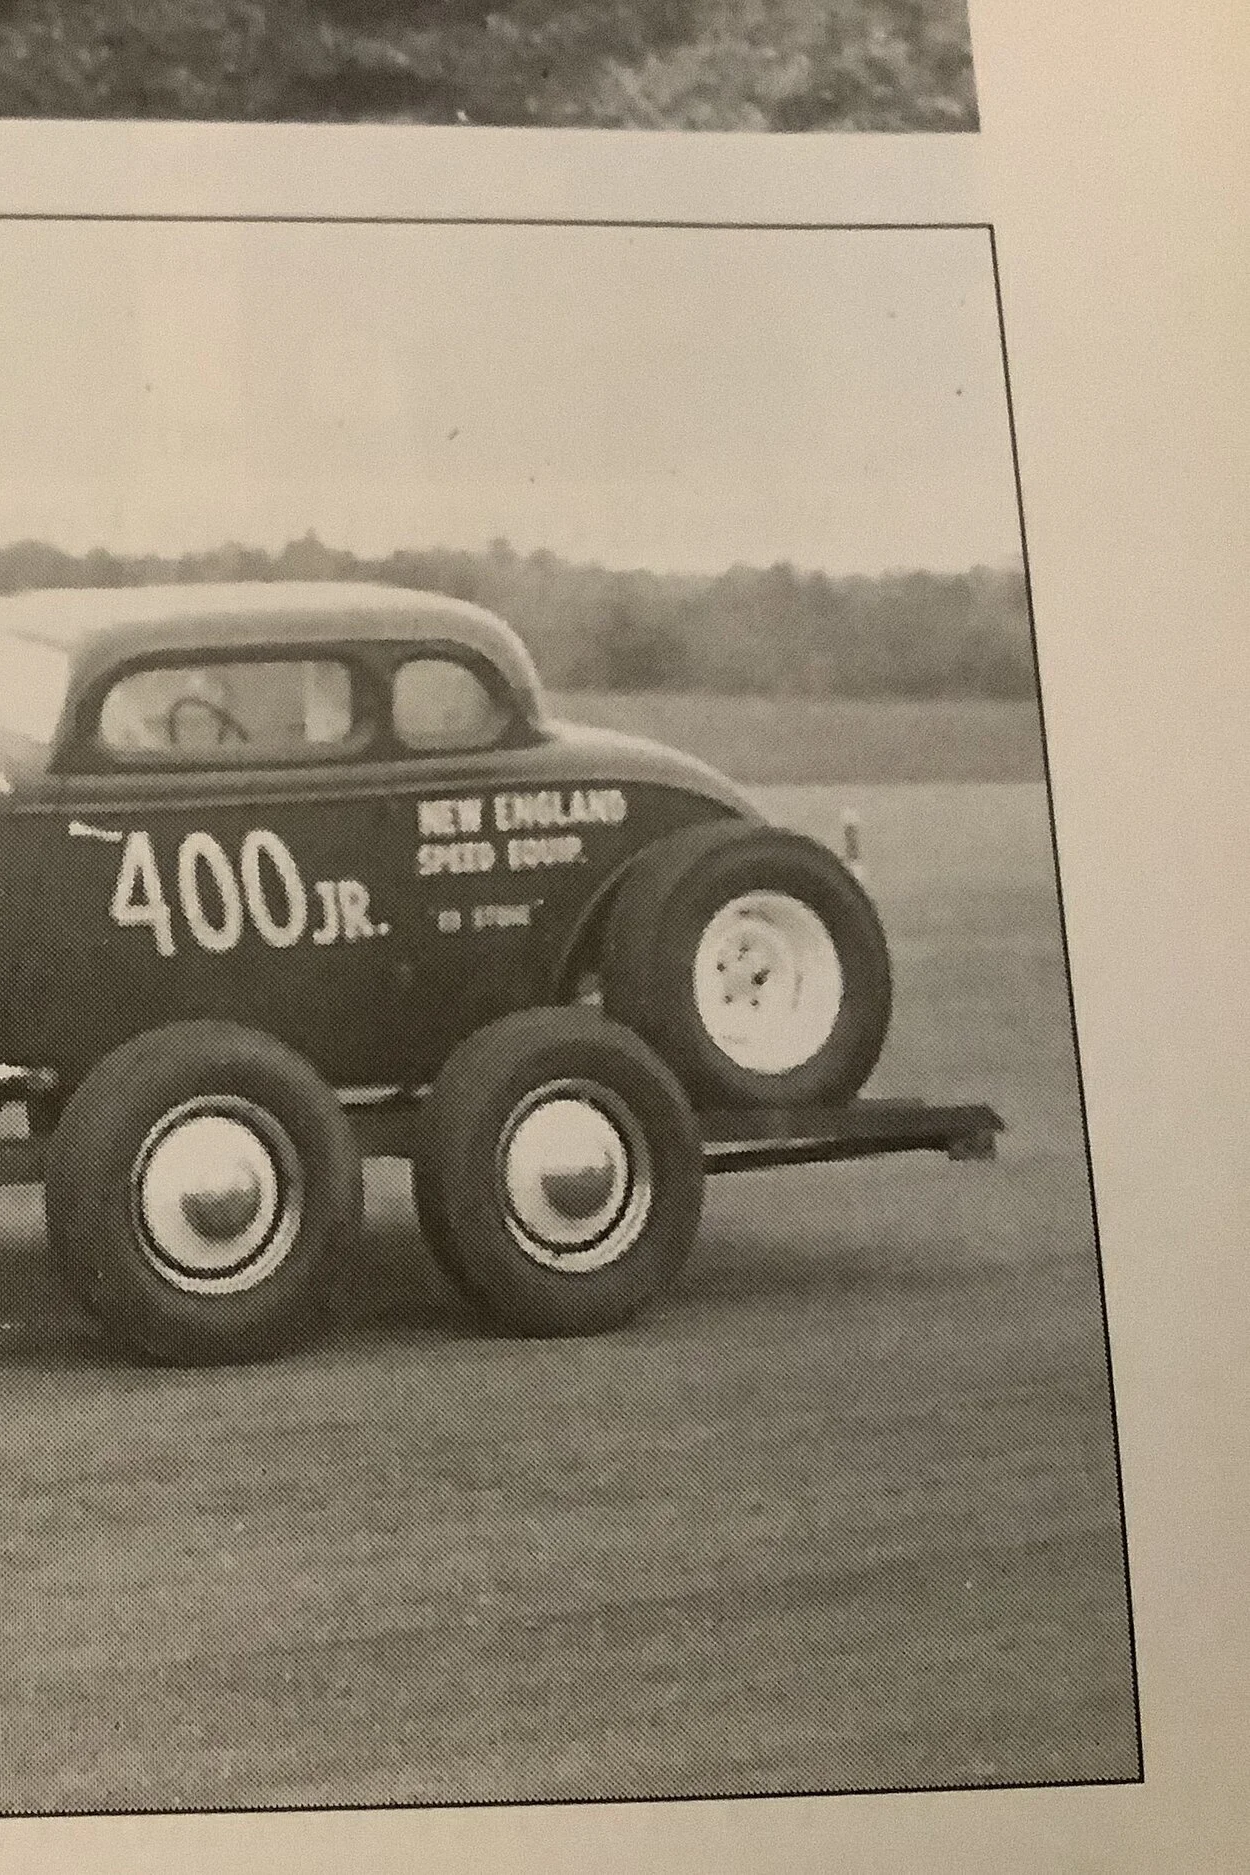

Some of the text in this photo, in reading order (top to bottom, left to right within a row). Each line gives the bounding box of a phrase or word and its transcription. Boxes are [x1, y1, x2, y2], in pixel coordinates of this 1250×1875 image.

[418, 789, 627, 836] NEW ENGLAND
[417, 841, 496, 876] SPEED
[109, 829, 307, 956] 400
